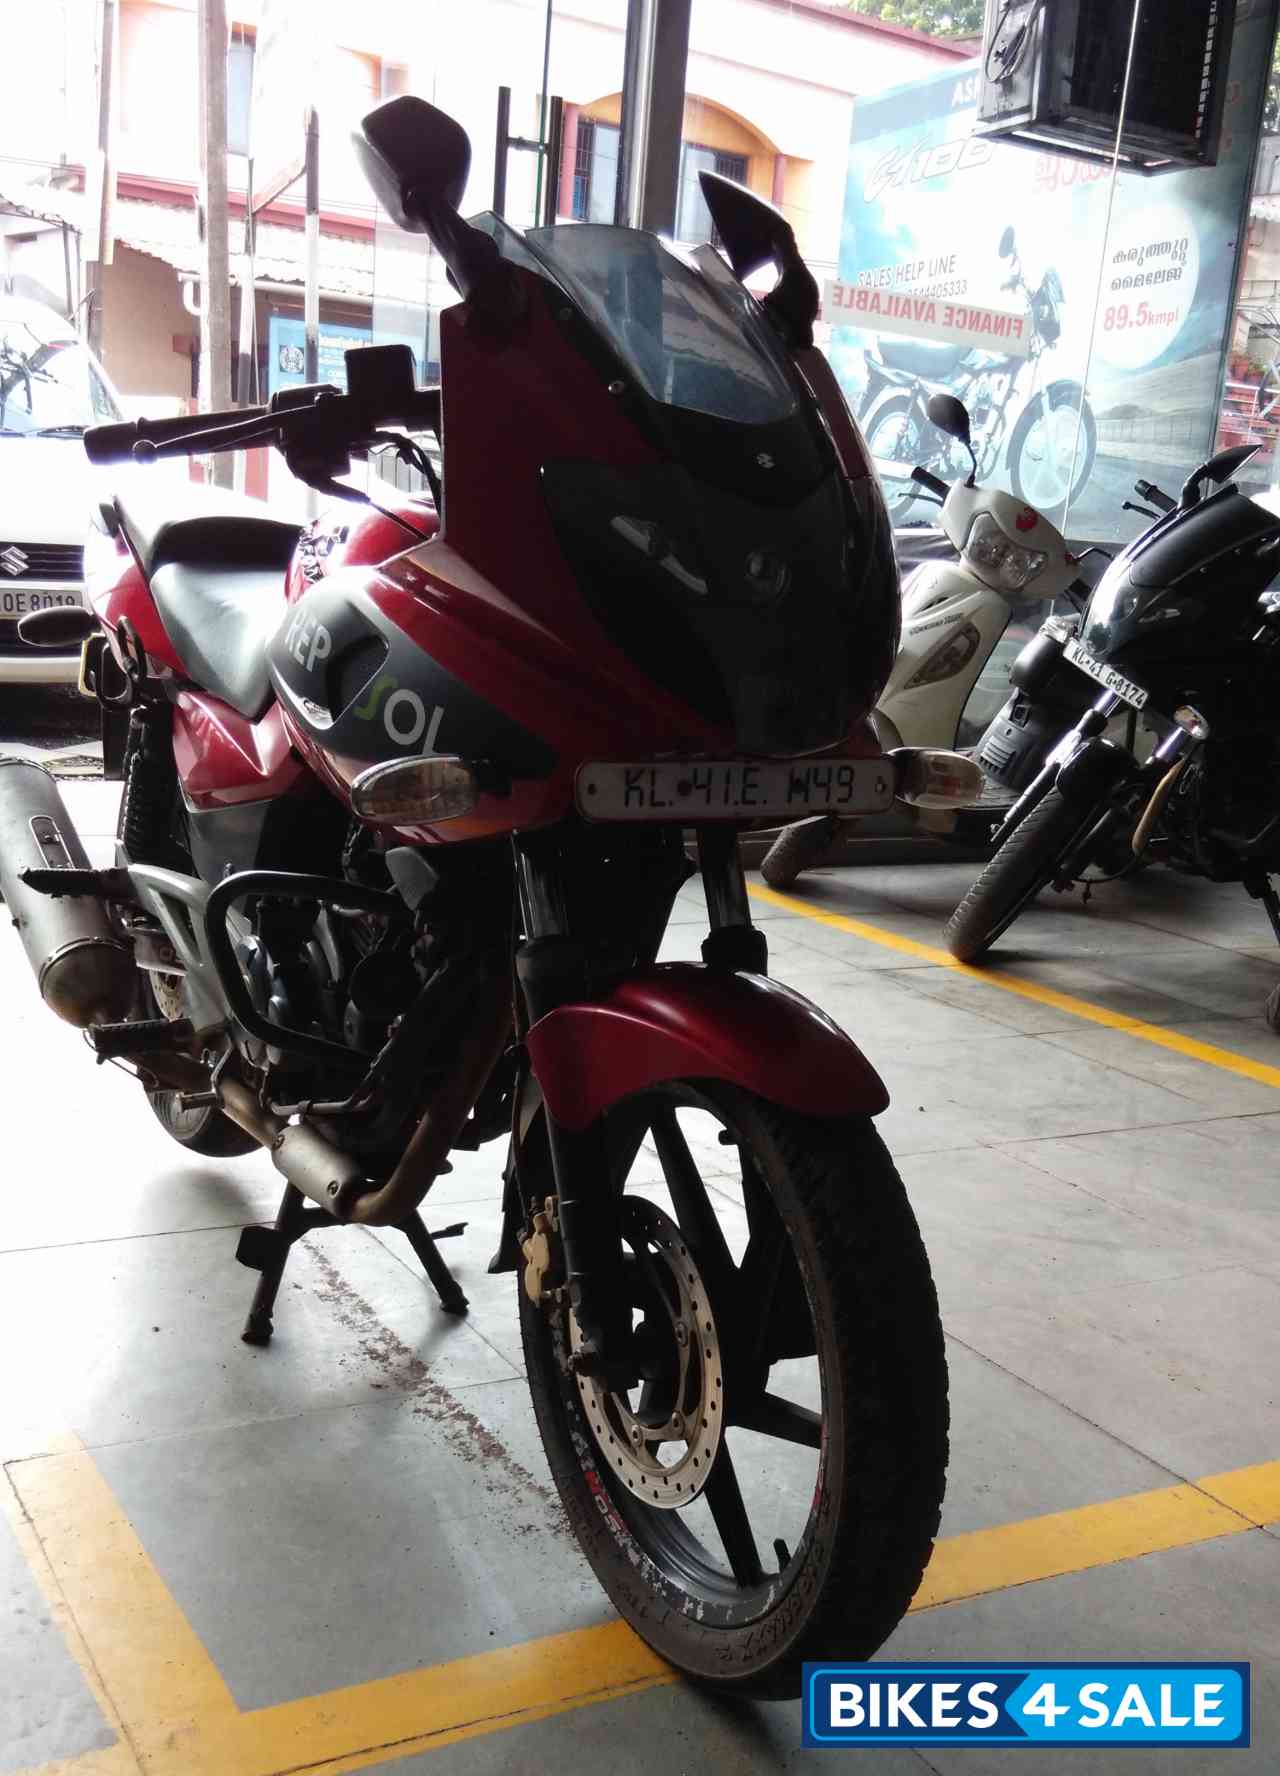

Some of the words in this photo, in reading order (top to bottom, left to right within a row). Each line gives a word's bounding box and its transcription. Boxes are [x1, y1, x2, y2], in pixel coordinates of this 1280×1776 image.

[857, 267, 893, 288] SALES
[896, 260, 926, 282] HELP
[928, 254, 958, 278] LINE
